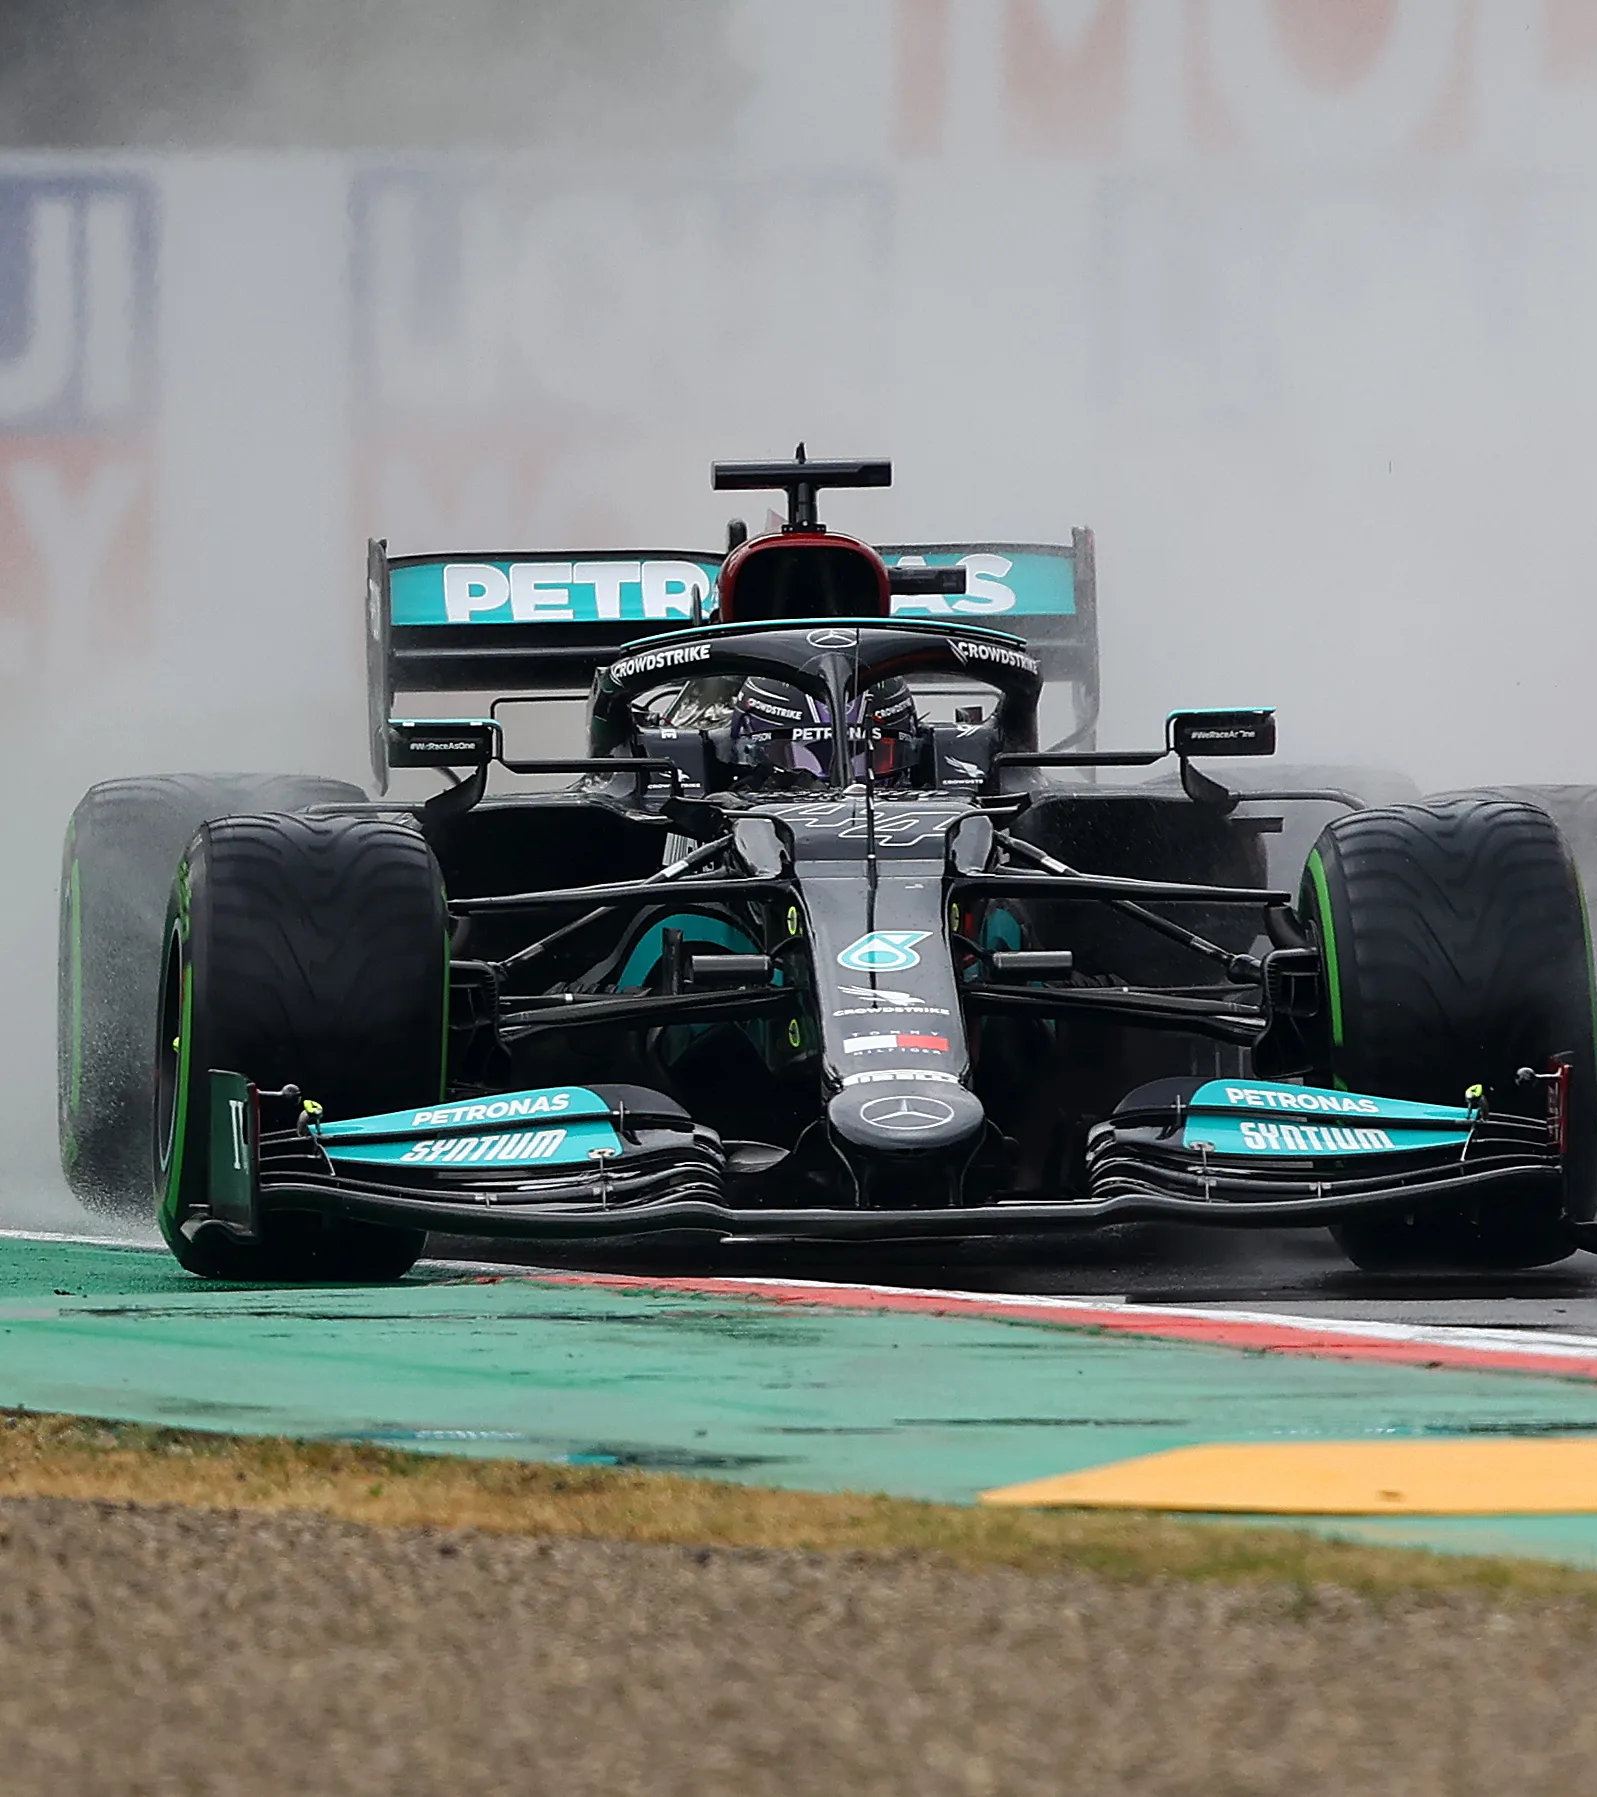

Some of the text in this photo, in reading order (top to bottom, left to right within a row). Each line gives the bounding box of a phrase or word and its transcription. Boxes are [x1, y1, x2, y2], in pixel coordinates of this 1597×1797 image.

[443, 553, 1018, 622] PETRAS
[614, 644, 711, 679] CROWDSTRIKE
[792, 727, 882, 741] PETRNS
[833, 1007, 950, 1017] CROWDSTRIKE
[411, 1092, 570, 1127] PETRONAS
[1224, 1087, 1379, 1113] PETRONAS
[399, 1128, 568, 1161] SYNTIUM
[1240, 1121, 1396, 1151] SYNTIUM
